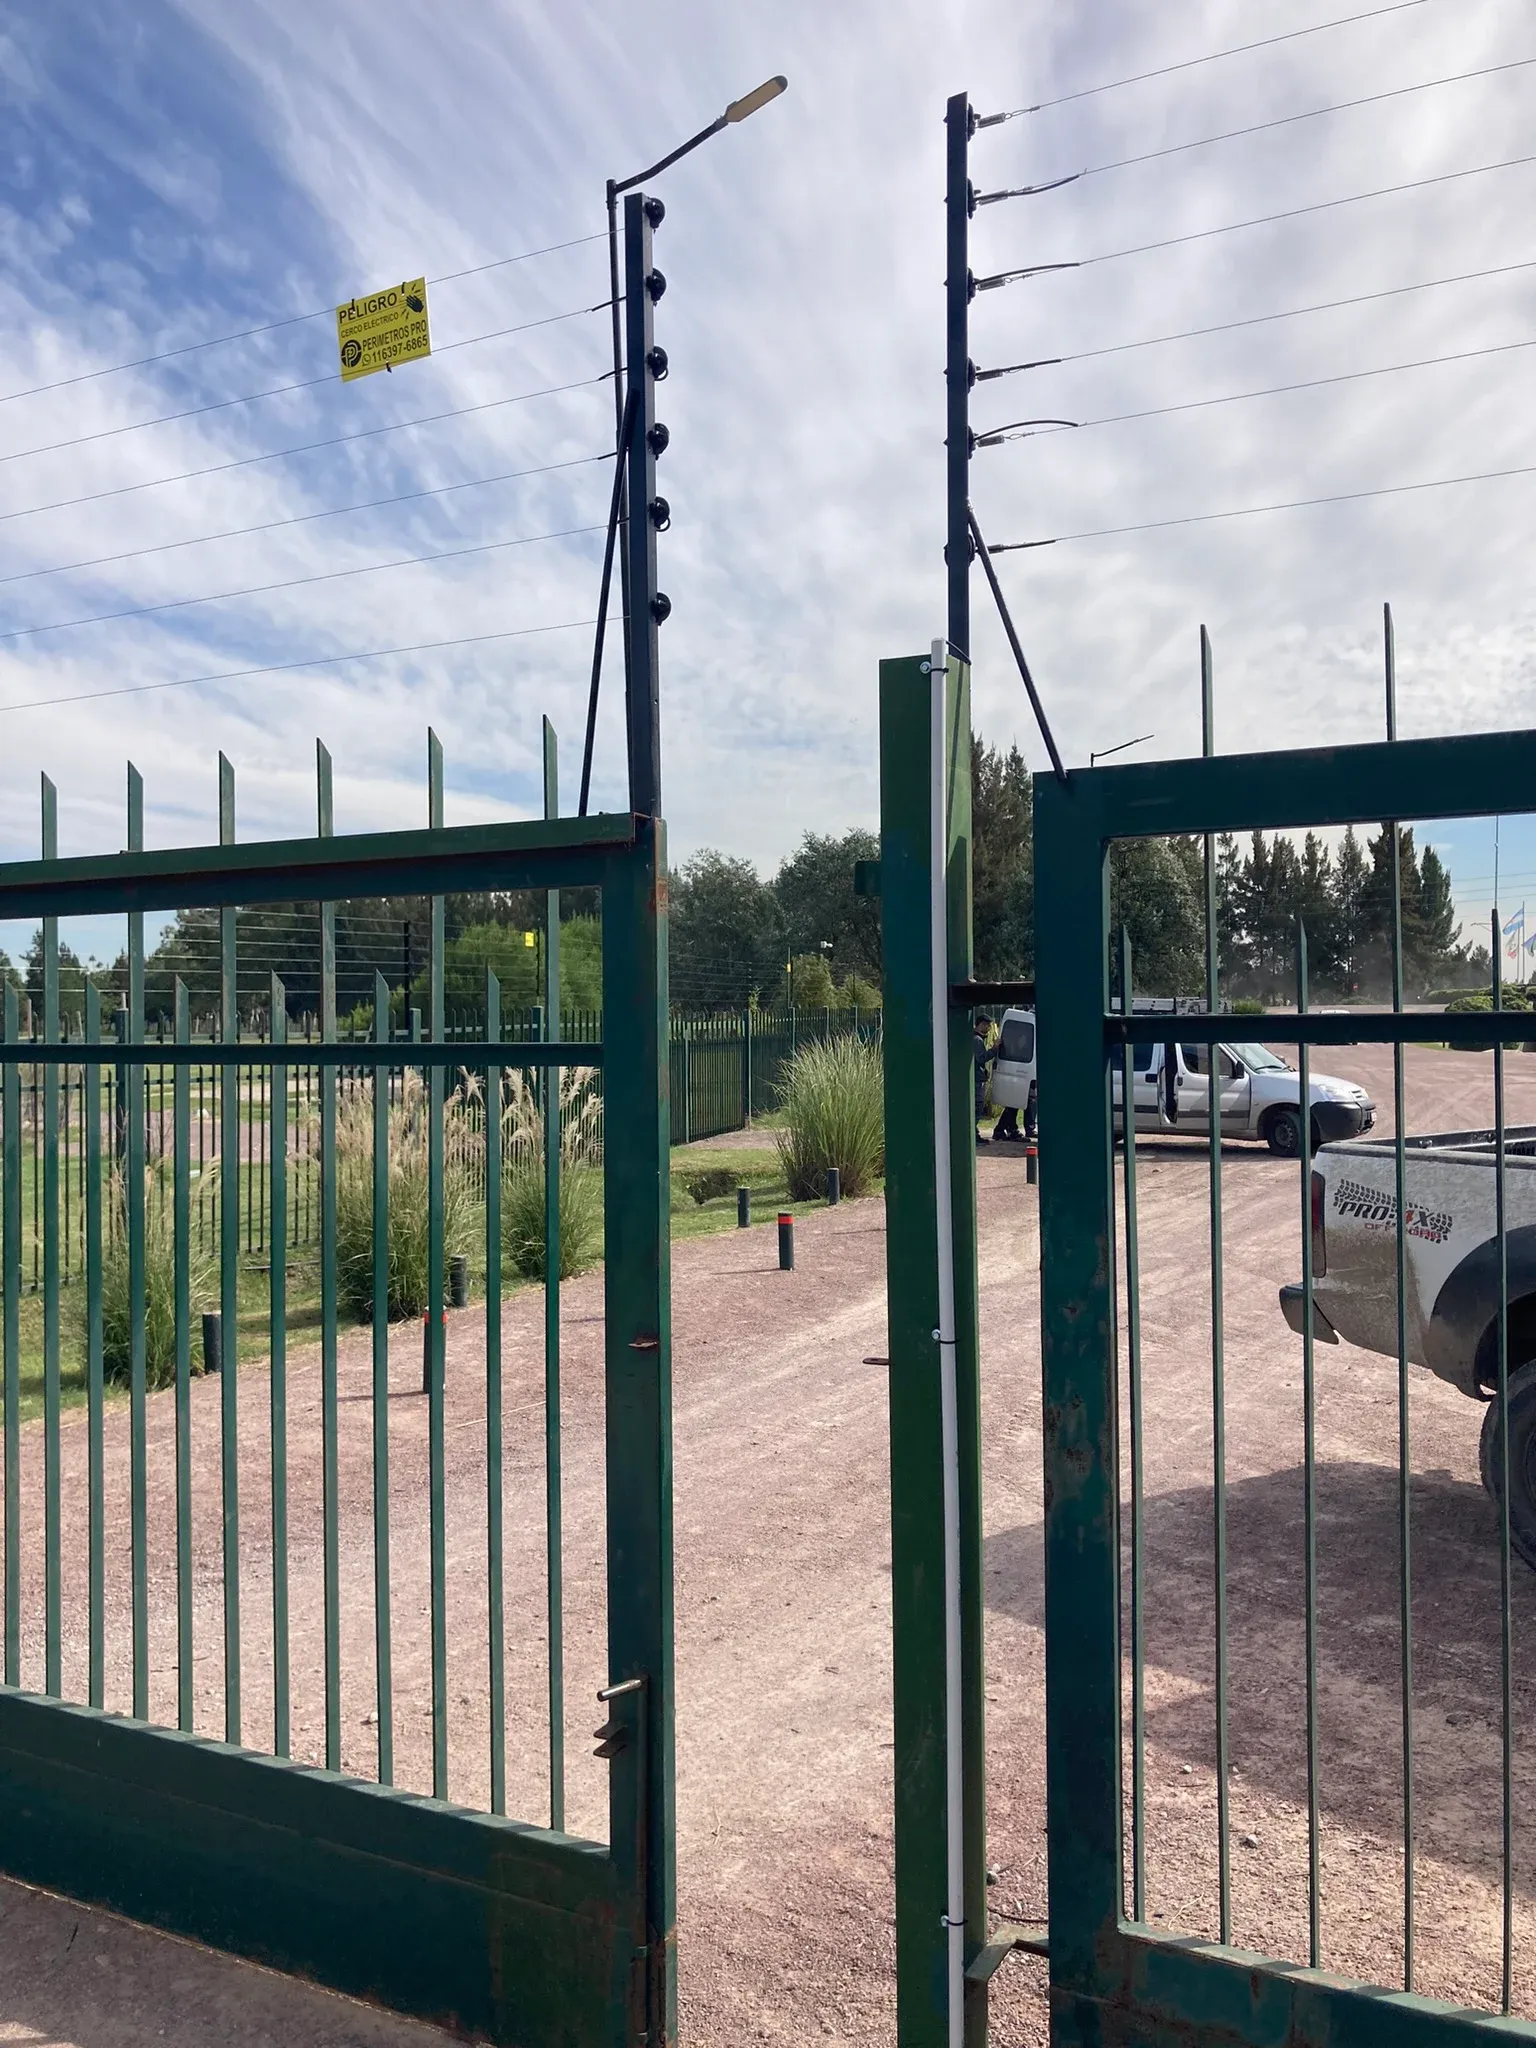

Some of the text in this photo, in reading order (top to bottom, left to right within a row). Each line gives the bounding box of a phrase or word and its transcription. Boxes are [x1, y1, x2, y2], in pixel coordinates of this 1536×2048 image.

[340, 292, 397, 323] PELIGRO
[341, 324, 362, 338] CERCO
[362, 320, 427, 351] PERIMETROS PRO
